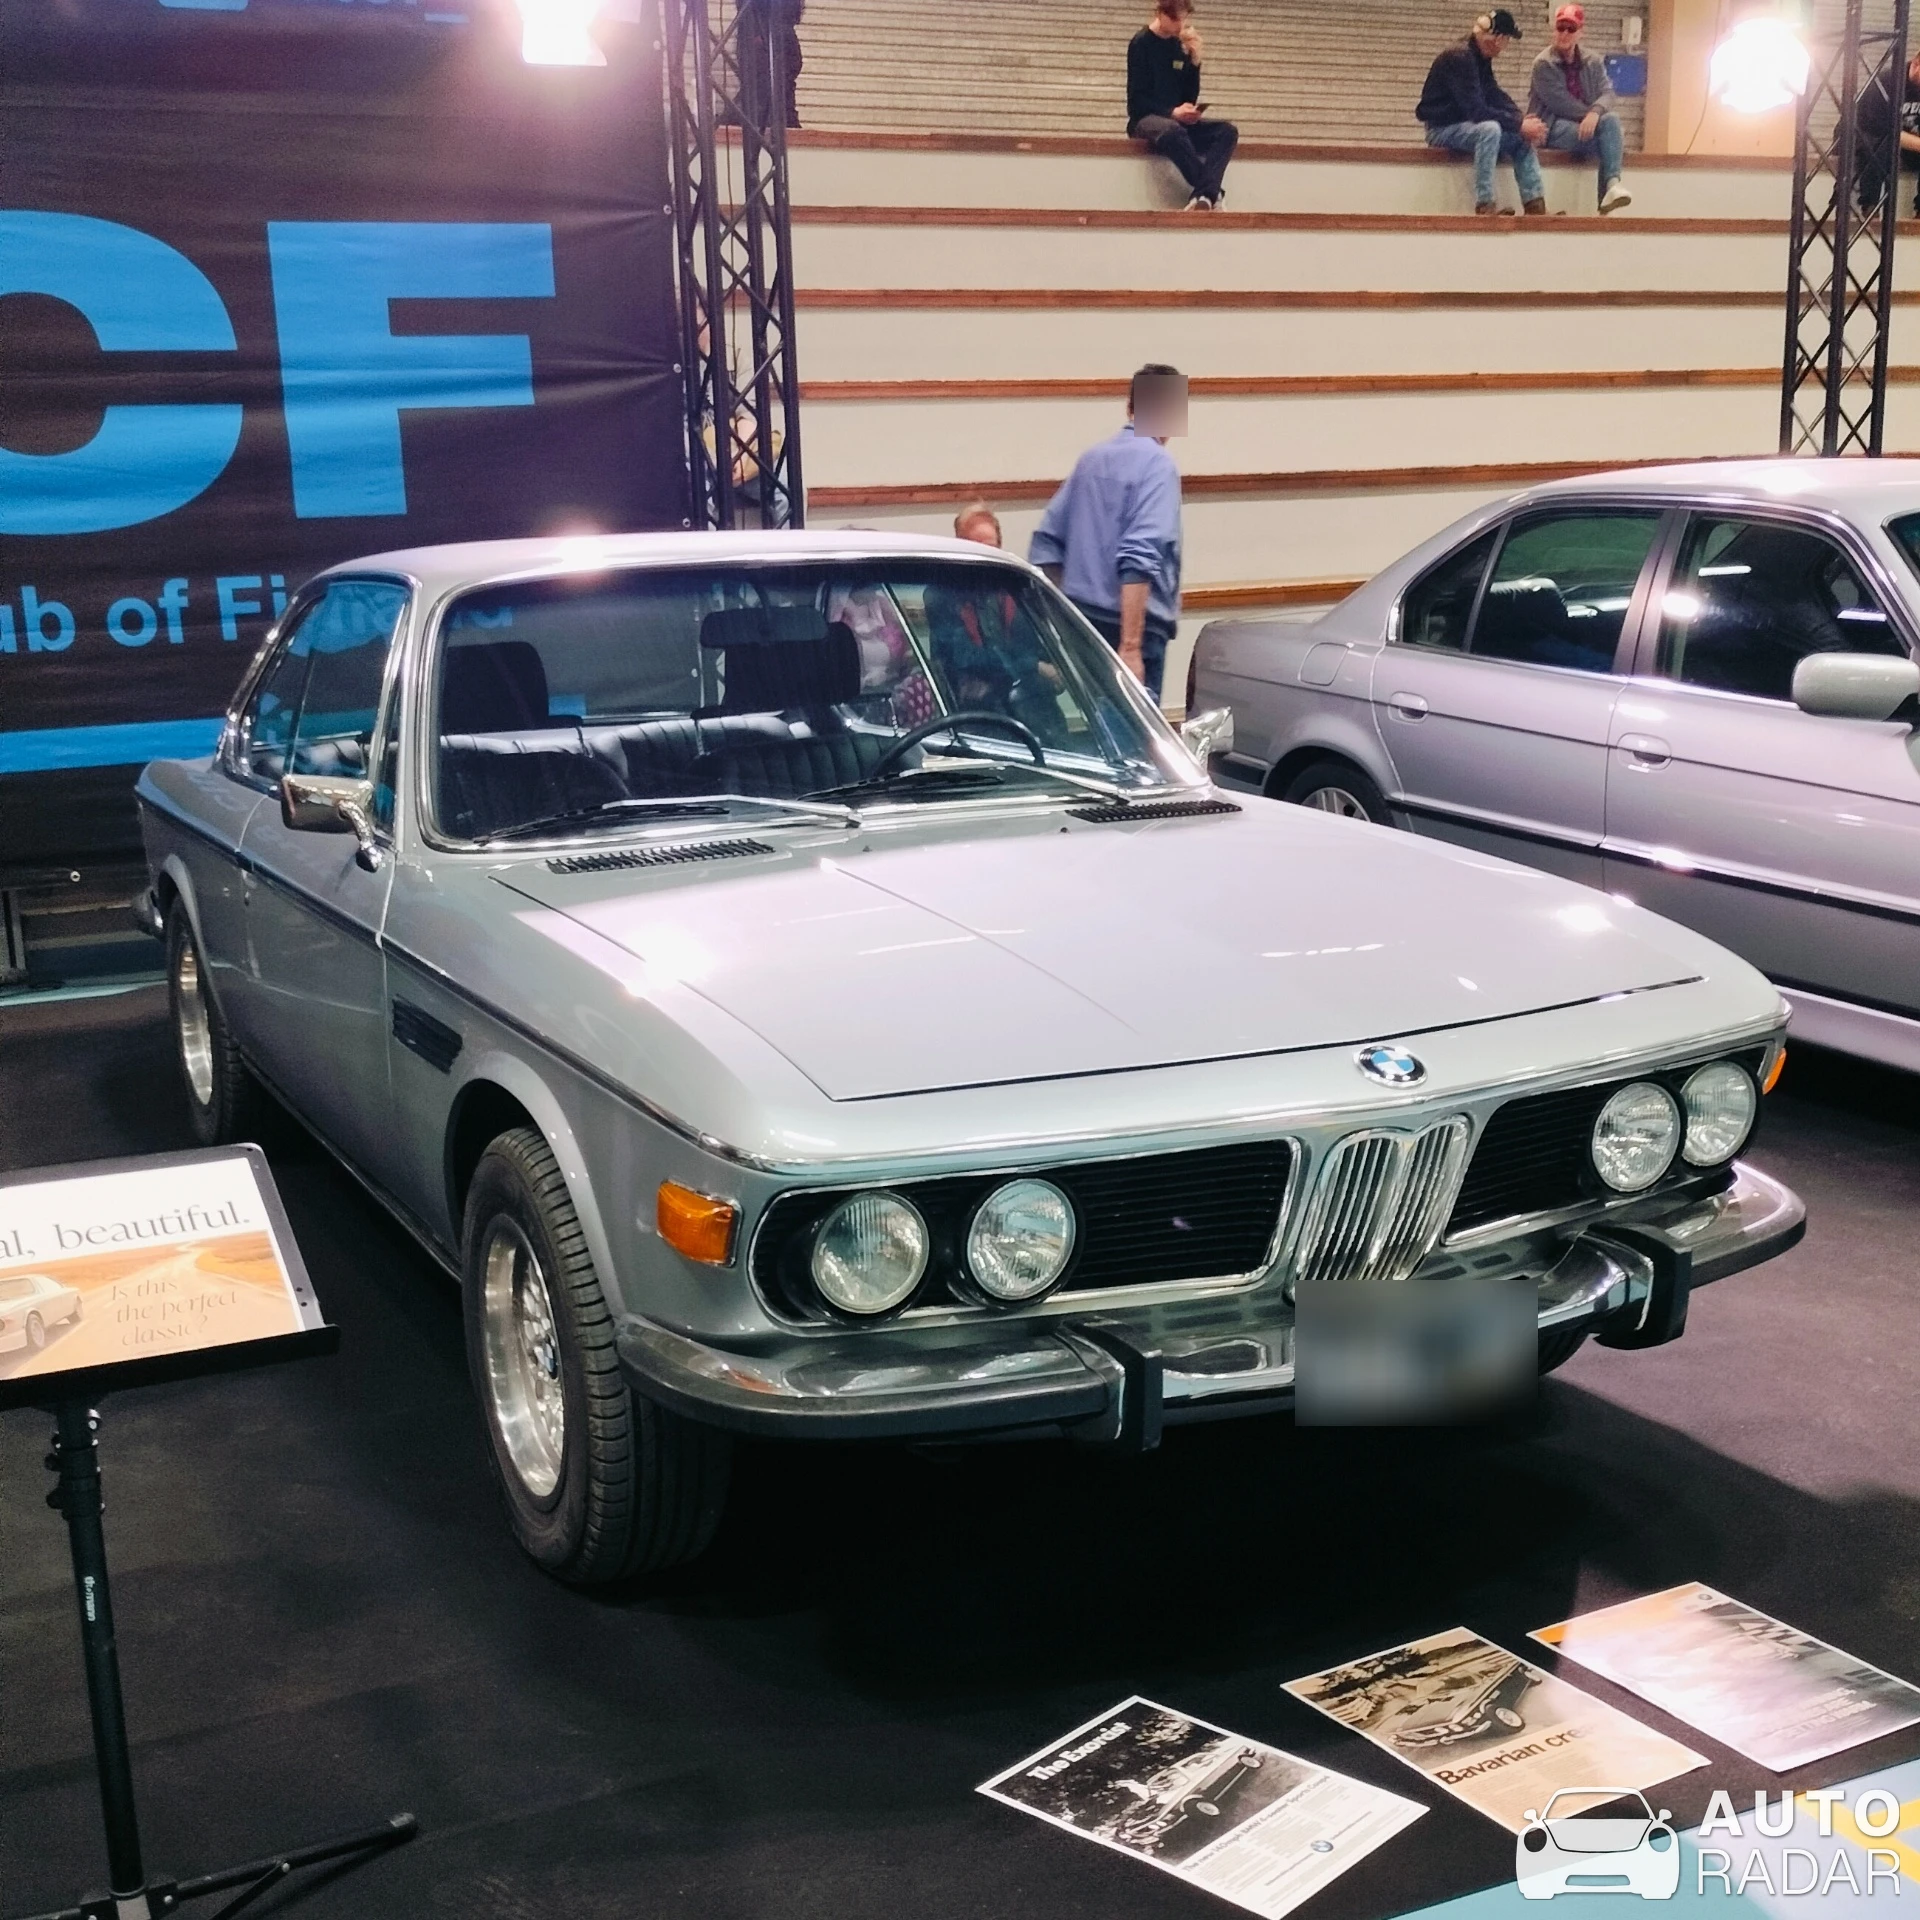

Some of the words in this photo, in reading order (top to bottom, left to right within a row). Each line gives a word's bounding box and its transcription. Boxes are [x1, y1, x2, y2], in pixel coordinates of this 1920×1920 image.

[107, 578, 189, 647] of
[53, 1201, 250, 1250] beautiful.
[112, 1285, 128, 1301] Is
[137, 1279, 178, 1297] this
[117, 1304, 153, 1323] the
[162, 1291, 236, 1320] perfect
[122, 1314, 208, 1346] classic?
[1026, 1759, 1071, 1781] The
[1058, 1721, 1133, 1763] Exorcist
[1432, 1742, 1547, 1786] Bavarian
[1239, 1820, 1263, 1834] BMW
